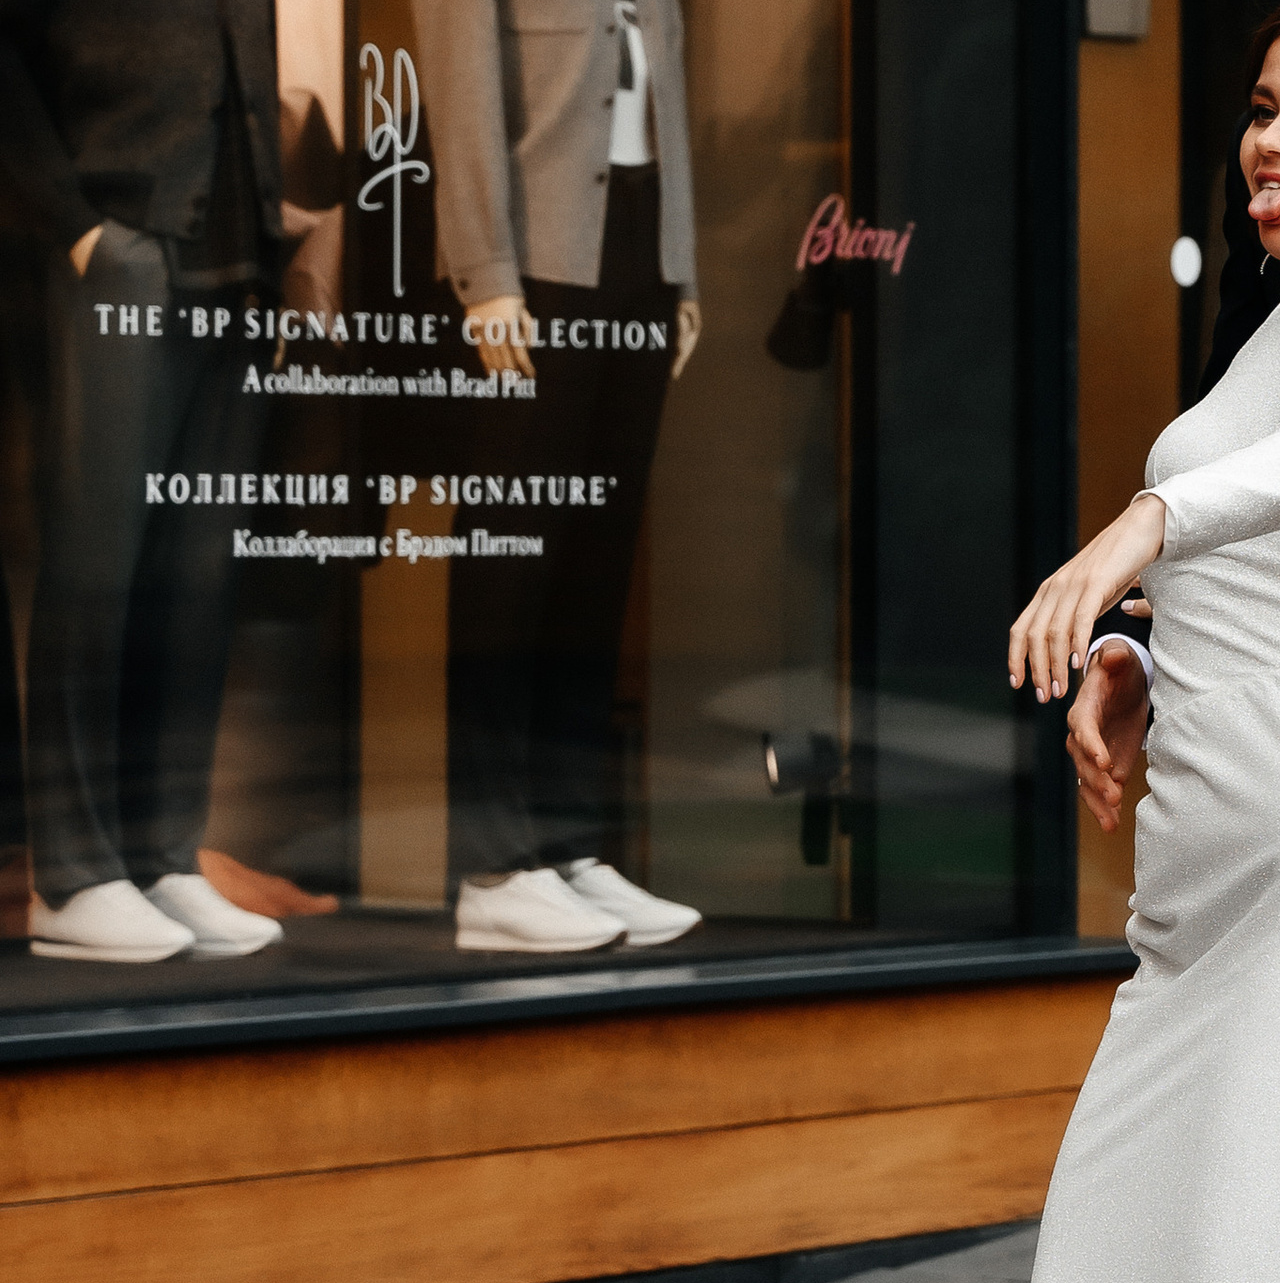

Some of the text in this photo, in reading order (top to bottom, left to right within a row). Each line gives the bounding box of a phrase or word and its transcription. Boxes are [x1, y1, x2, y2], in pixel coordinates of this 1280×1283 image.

[93, 303, 163, 337] THE
[461, 315, 667, 350] COLLECTION
[242, 364, 261, 393] A
[264, 364, 399, 396] collaboration
[402, 368, 447, 397] with
[450, 368, 499, 399] Brad
[145, 473, 349, 506] КОЛЛЕКЦИЯ
[379, 536, 393, 558] с
